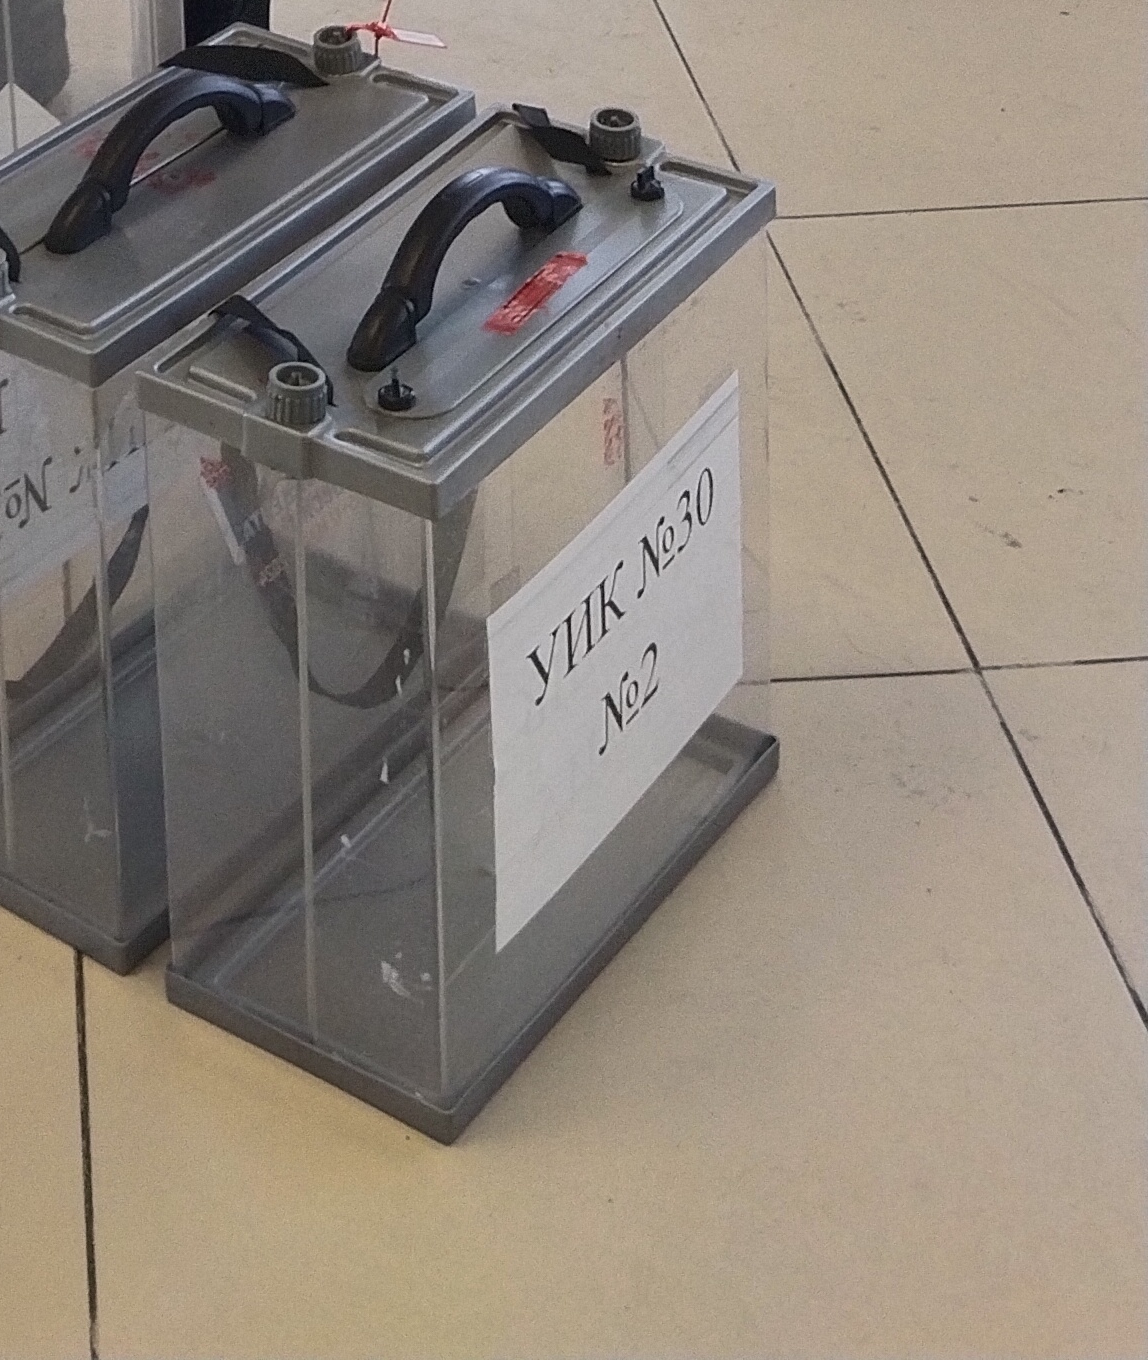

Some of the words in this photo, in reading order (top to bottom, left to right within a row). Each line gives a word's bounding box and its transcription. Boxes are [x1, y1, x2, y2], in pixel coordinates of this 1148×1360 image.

[526, 559, 626, 707] УИК
[636, 466, 715, 599] №30
[598, 641, 661, 757] №2
